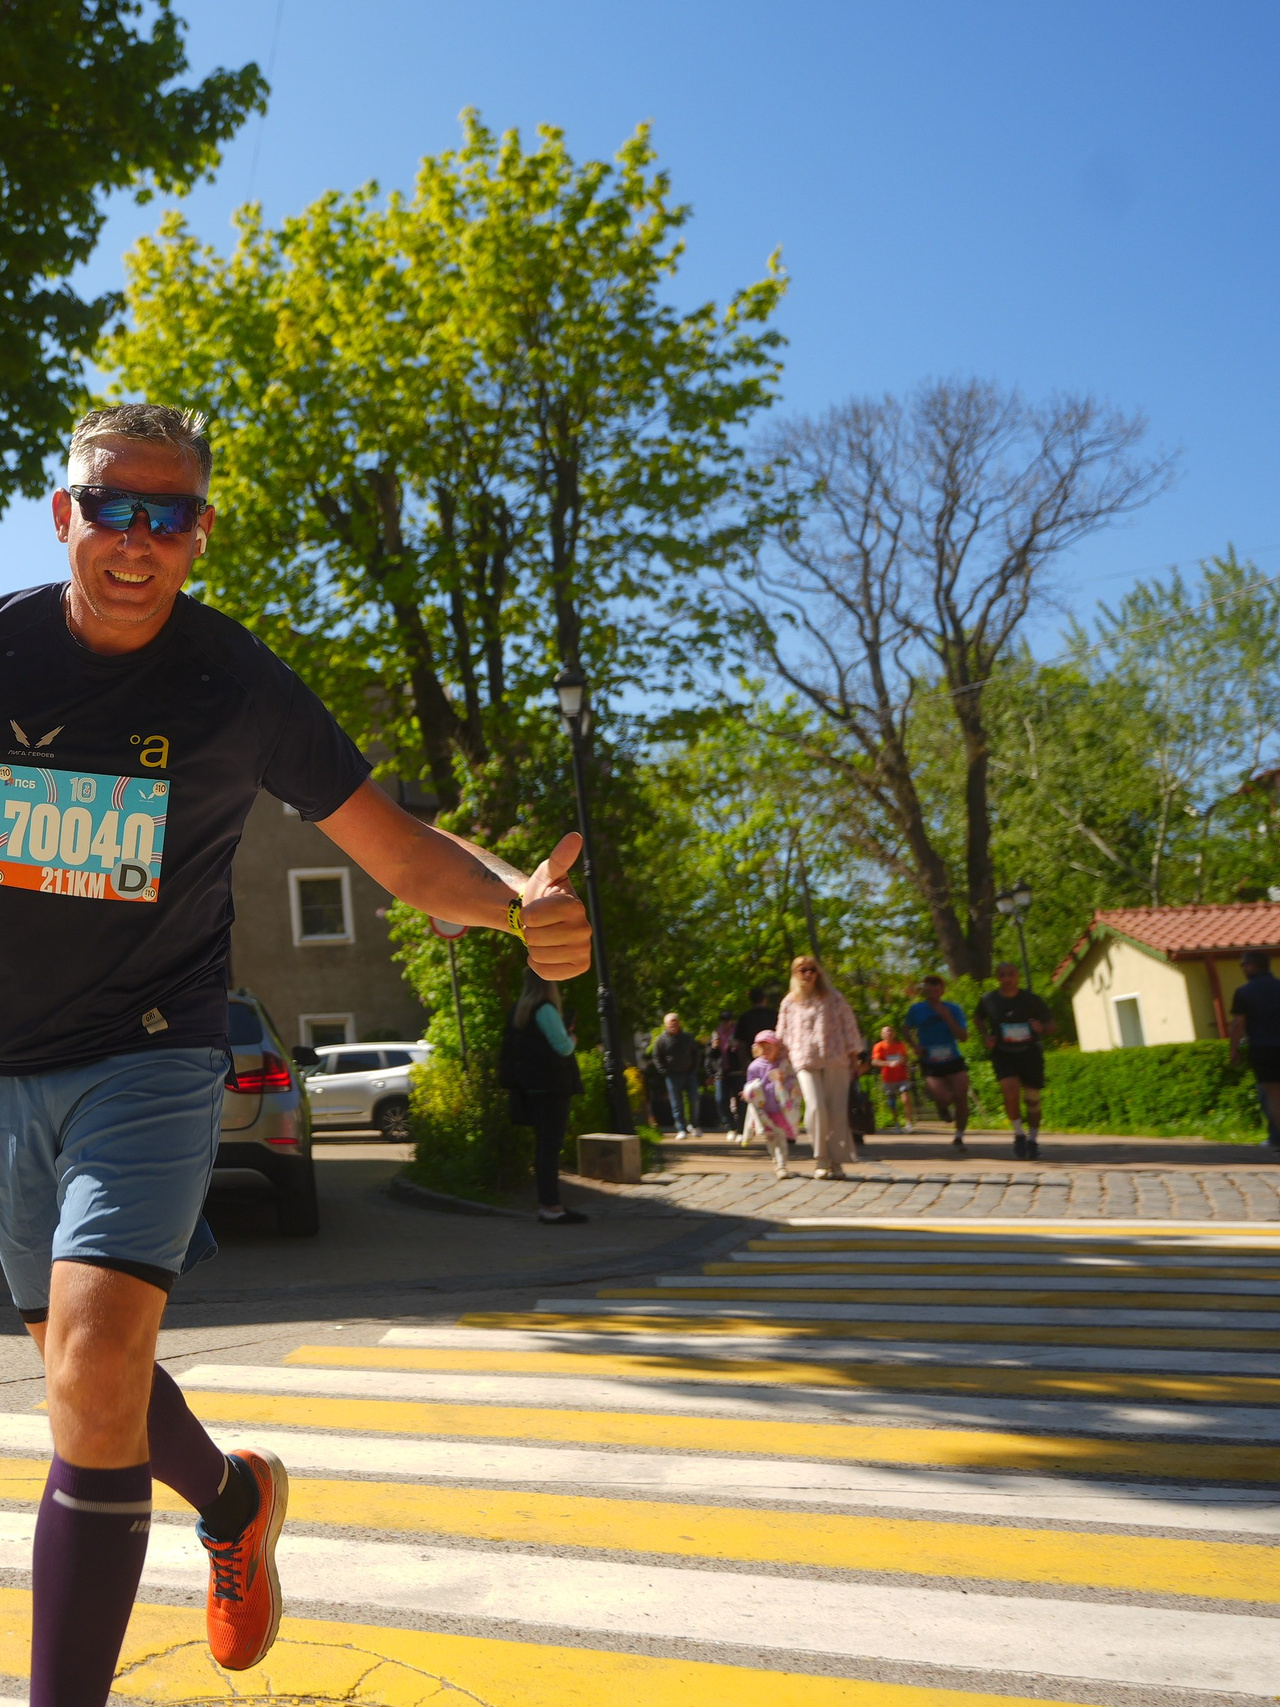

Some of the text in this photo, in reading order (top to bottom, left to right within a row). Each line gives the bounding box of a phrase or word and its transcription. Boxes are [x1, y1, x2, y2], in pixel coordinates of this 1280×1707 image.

[7, 749, 55, 759] ЛИГА ГЕРОЕВ
[14, 778, 36, 790] ПСБ
[4, 799, 155, 870] 70040
[117, 863, 148, 892] D
